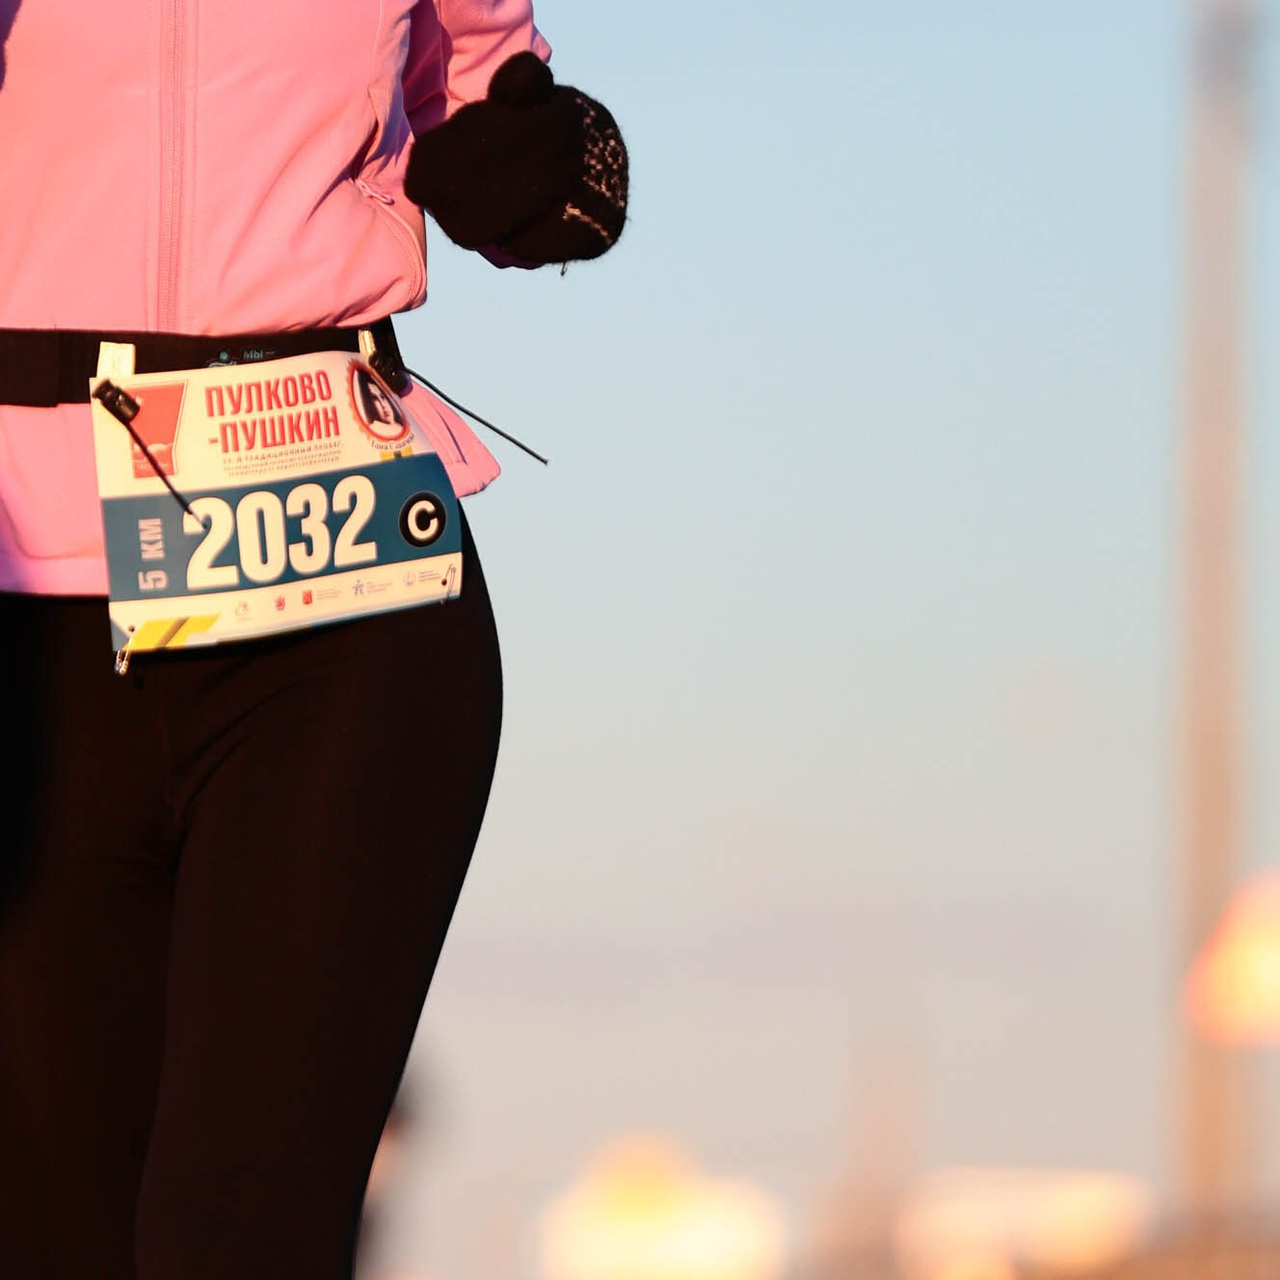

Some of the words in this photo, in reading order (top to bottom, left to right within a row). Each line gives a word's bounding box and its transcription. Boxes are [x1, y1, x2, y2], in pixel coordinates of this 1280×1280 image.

[204, 369, 332, 417] ПУЛКОВО
[208, 405, 340, 453] -ПУШКИН
[183, 474, 377, 590] 2032
[137, 569, 168, 592] 5
